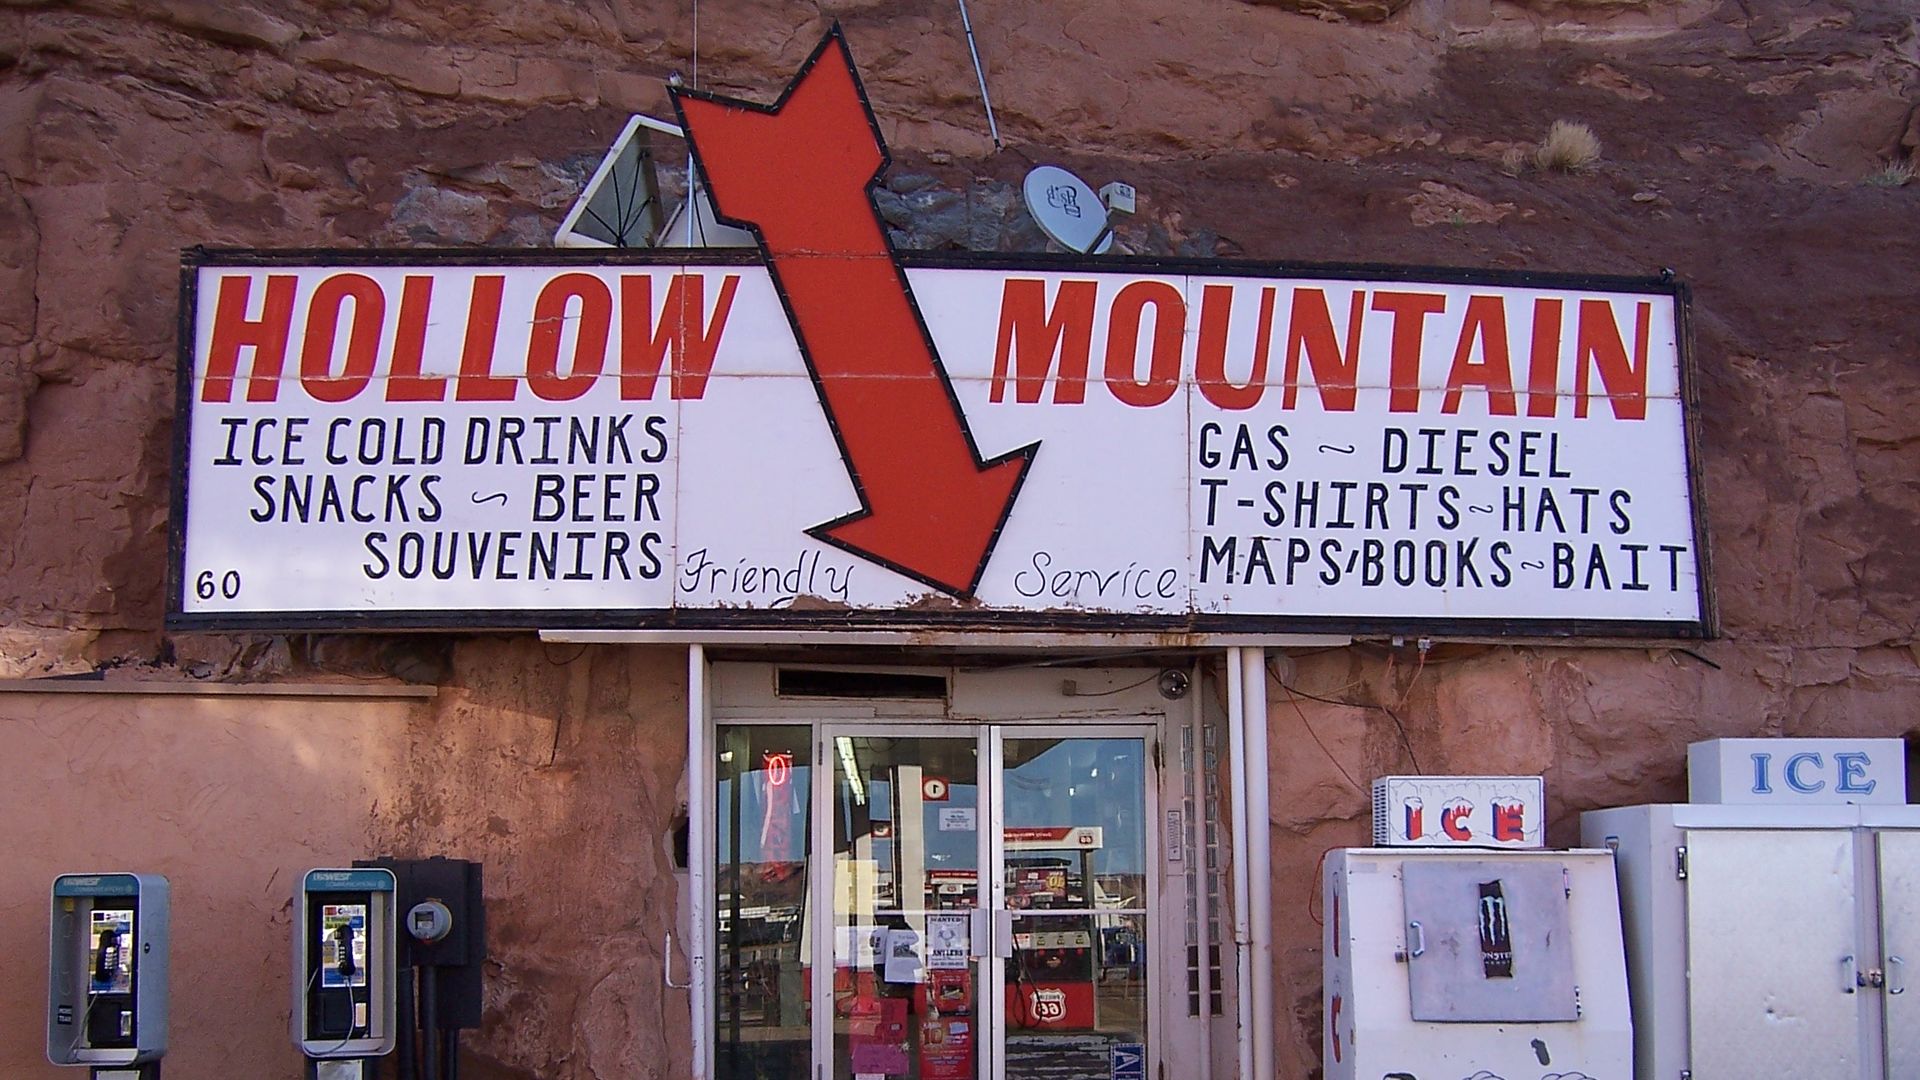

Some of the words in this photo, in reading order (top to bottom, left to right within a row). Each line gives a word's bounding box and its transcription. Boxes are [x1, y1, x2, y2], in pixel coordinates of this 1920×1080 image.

[201, 273, 740, 402] HOLLOW
[989, 278, 1651, 420] MOUNTAIN
[213, 417, 309, 466] ICE
[325, 417, 445, 465] COLD
[464, 414, 668, 465] DRINKS
[1199, 422, 1290, 471] GAS
[1382, 427, 1571, 478] DIESEL
[250, 474, 442, 523] SNACKS
[532, 473, 661, 522] BEER
[363, 531, 662, 581] SOUVENIRS
[680, 548, 855, 602] Friendly
[1014, 551, 1178, 599] Service
[196, 570, 240, 600] 60
[1750, 752, 1877, 795] ICE
[1405, 800, 1524, 841] ICE
